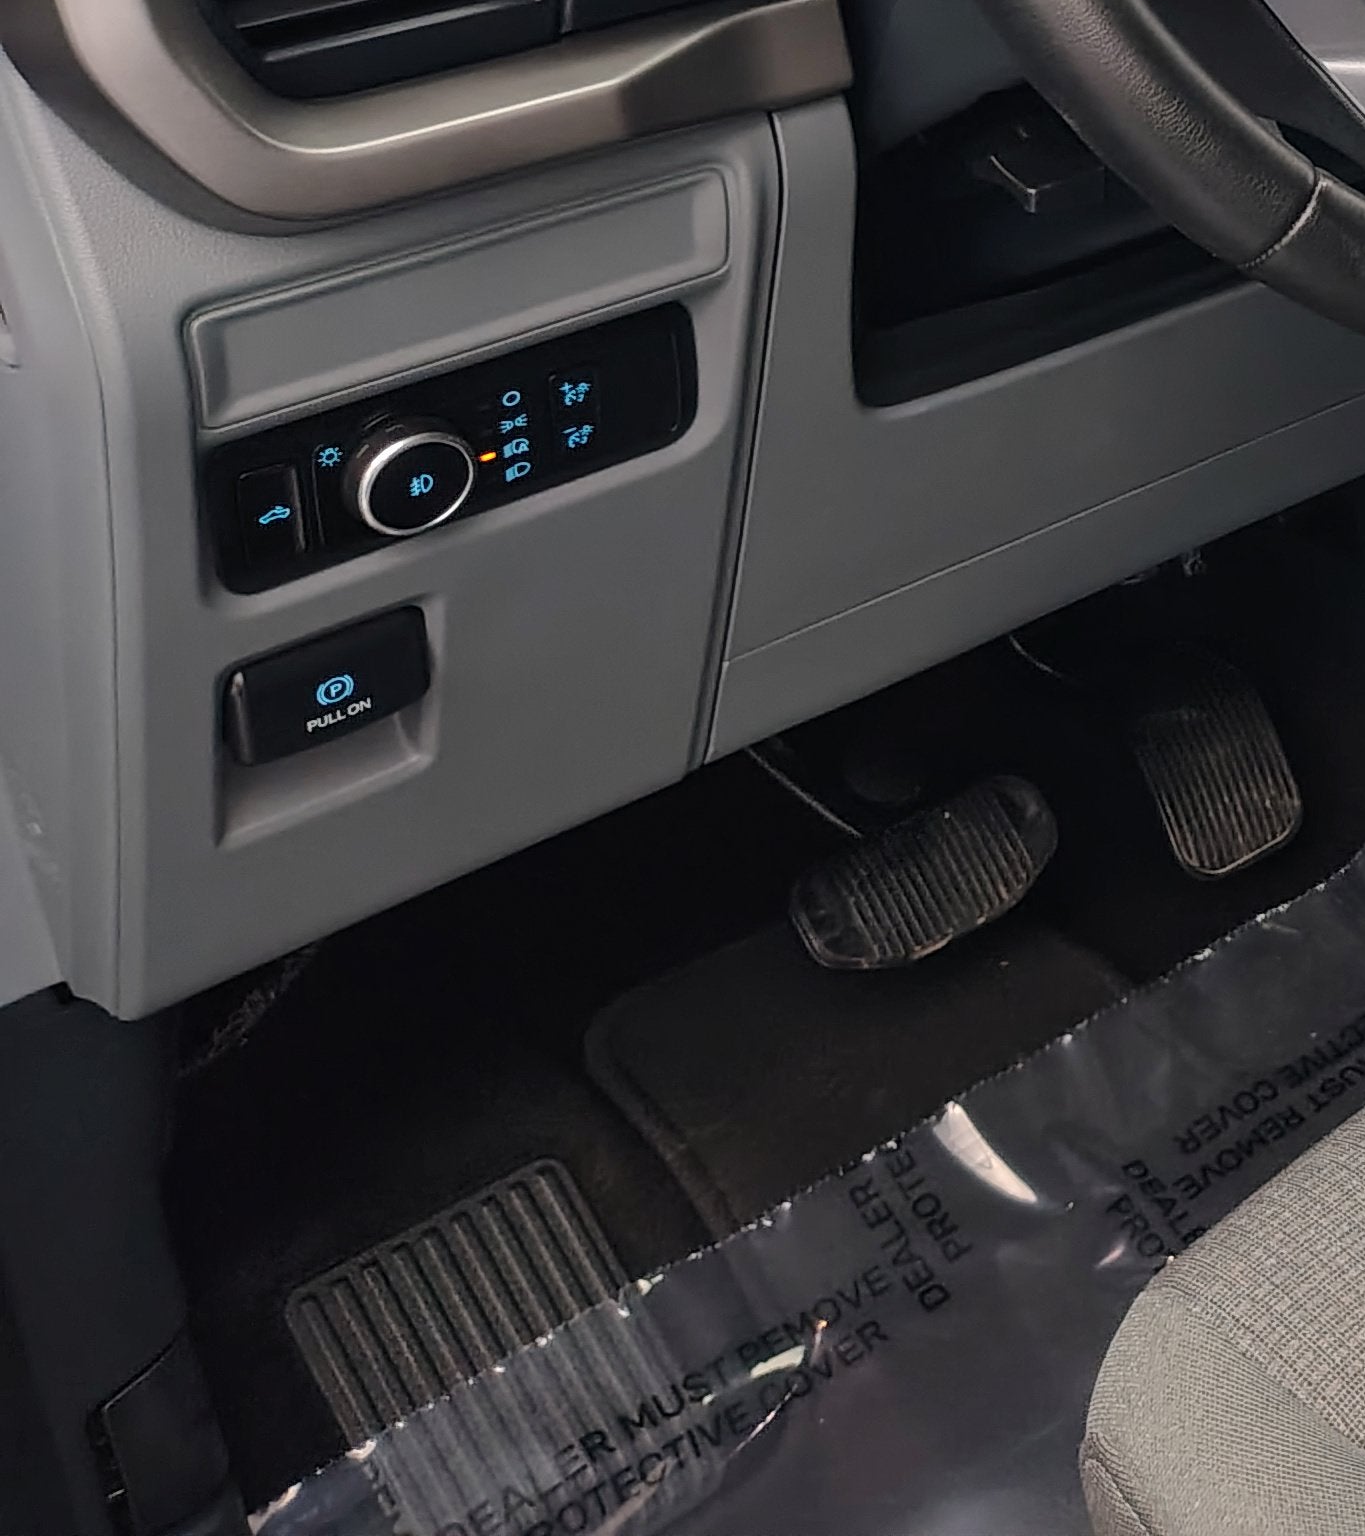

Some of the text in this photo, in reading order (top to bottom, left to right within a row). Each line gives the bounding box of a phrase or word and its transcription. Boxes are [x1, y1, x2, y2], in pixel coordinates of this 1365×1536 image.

[306, 696, 372, 733] PULL ON
[1172, 1102, 1306, 1201] REMOVE
[1173, 1076, 1281, 1155] COVER
[849, 1173, 951, 1314] DEALER
[882, 1146, 975, 1265] PROTE
[1104, 1193, 1168, 1259] PRO
[616, 1357, 732, 1440] MUST
[759, 1318, 890, 1413] COVER
